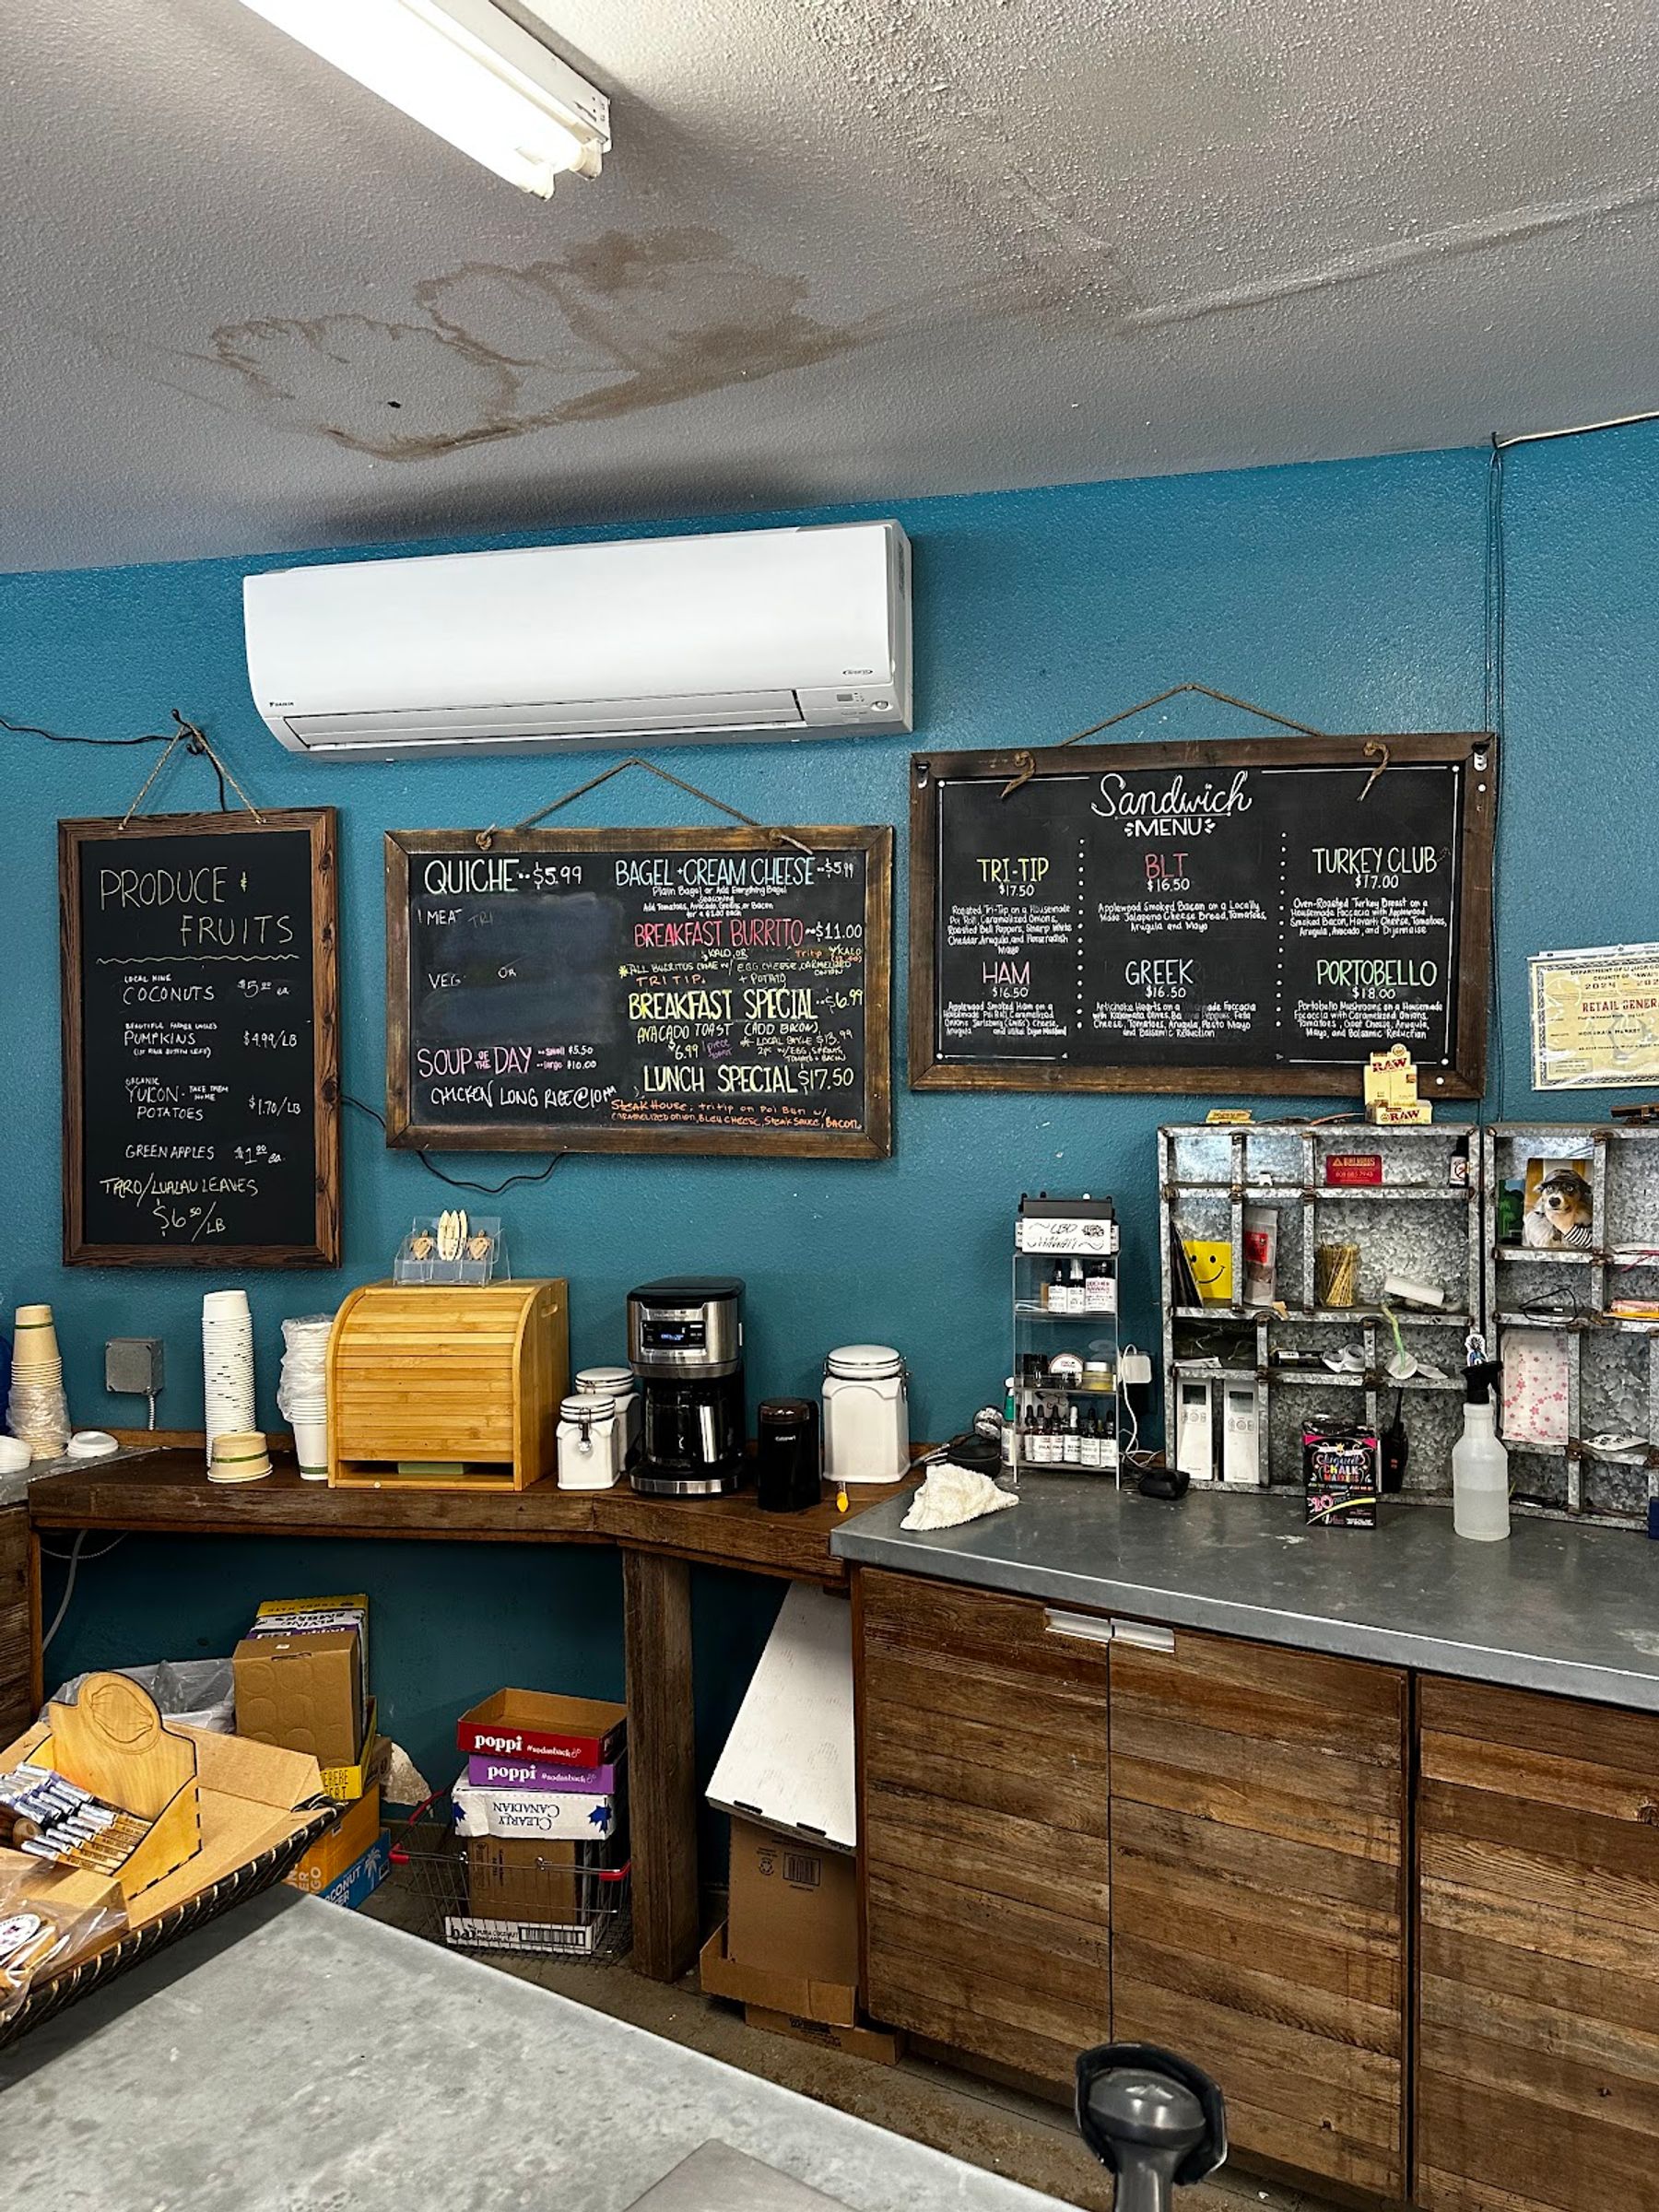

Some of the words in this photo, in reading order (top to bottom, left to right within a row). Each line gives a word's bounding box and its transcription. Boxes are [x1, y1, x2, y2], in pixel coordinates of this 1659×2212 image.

[1090, 771, 1252, 818] Sandwich
[1135, 818, 1203, 837] MENU
[976, 857, 1049, 882] TRI-TIP
[1144, 853, 1189, 878] BLT
[1312, 848, 1382, 874] TURKEY
[1387, 847, 1437, 874] CLUB
[615, 859, 674, 887] BAGEL
[751, 857, 816, 885] CHEESE
[100, 866, 228, 911] PRODUCE
[999, 883, 1035, 897] $17.50
[1147, 877, 1190, 892] $16.50
[1355, 875, 1399, 889] $17.00
[180, 915, 294, 947] FRUITS
[634, 921, 723, 947] BREAKFAST
[730, 918, 804, 947] BURRITO
[982, 961, 1030, 984] HAM
[1125, 959, 1194, 985] GREEK
[1317, 959, 1437, 987] PORTOBELLO
[123, 985, 215, 1005] COCONUTS
[992, 987, 1029, 998] $16.50
[1145, 985, 1186, 998] $16.50
[1352, 986, 1396, 999] $18.00
[629, 990, 732, 1020] BREAKFAST
[743, 988, 818, 1019] SPECIAL
[1583, 1001, 1619, 1012] RETAIL
[1623, 998, 1659, 1010] GENER
[124, 1030, 196, 1046] PUMPKINS
[694, 1023, 734, 1037] TOAST
[418, 1047, 472, 1077] SOUP
[475, 1060, 491, 1069] THE
[478, 1051, 489, 1059] OF
[494, 1046, 532, 1074] DAY
[1372, 1058, 1407, 1072] RAW
[644, 1065, 704, 1093] LUNCH
[717, 1065, 798, 1093] SPECIAL
[798, 1063, 854, 1095] $17.50
[430, 1080, 494, 1108] CHICKEN
[500, 1088, 538, 1106] LONG
[137, 1107, 204, 1121] POTATOES
[1390, 1111, 1420, 1121] RAW
[125, 1145, 168, 1159] GREEN
[171, 1147, 215, 1159] APPLES
[202, 1177, 258, 1196] LEAVES
[1324, 1465, 1359, 1475] CHALK
[475, 1735, 523, 1753] poppi
[488, 1764, 536, 1783] poppi
[494, 1802, 559, 1818] CANADIAN
[498, 1813, 552, 1831] CLEARLY
